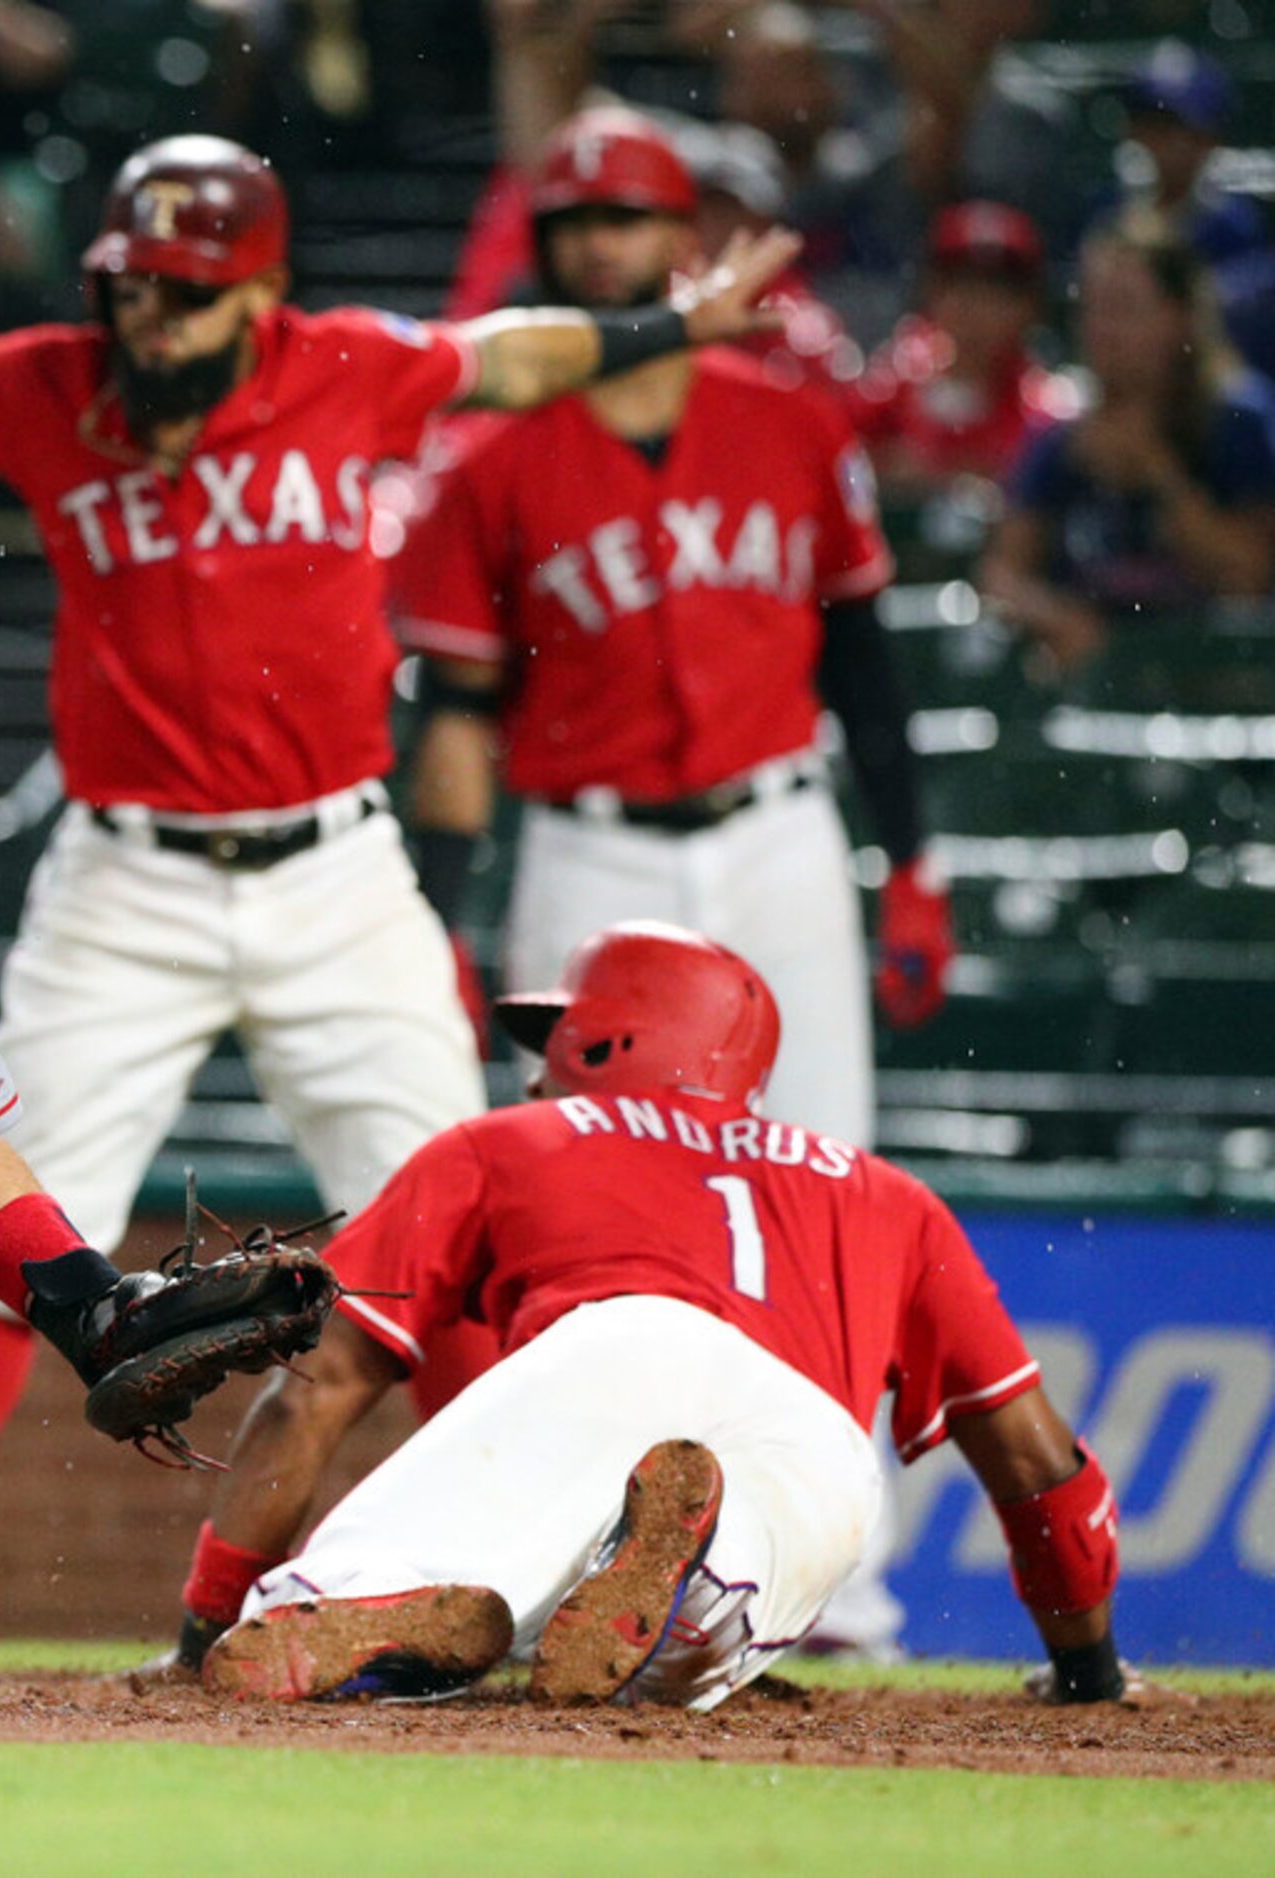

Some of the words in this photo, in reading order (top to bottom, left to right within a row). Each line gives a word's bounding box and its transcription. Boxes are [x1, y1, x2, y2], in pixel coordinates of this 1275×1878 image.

[134, 181, 194, 239] T
[57, 449, 369, 575] TEXAS
[556, 1096, 857, 1178] ANDRUS
[704, 1174, 771, 1304] 1
